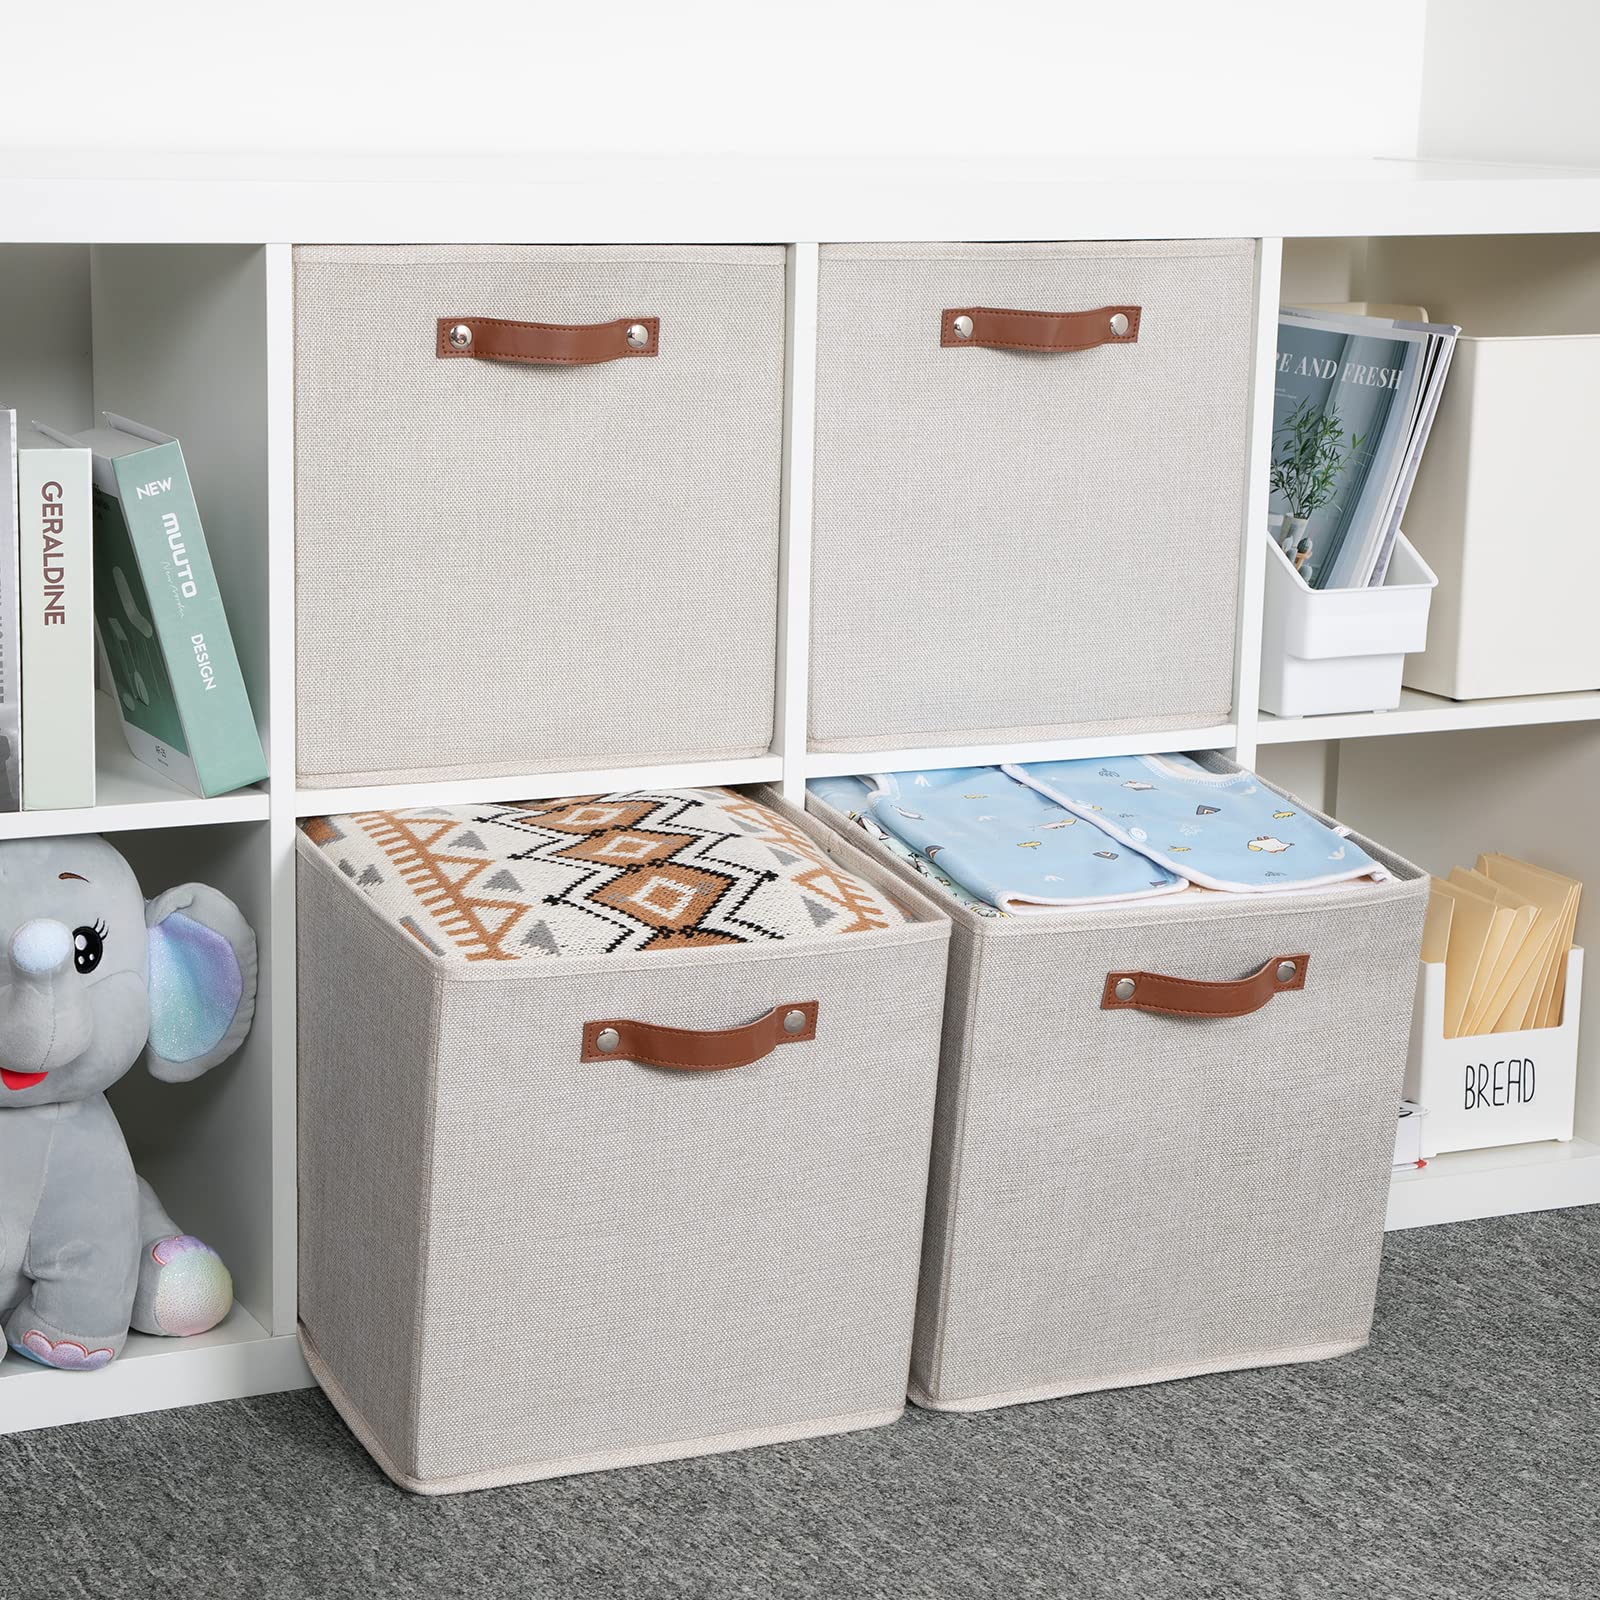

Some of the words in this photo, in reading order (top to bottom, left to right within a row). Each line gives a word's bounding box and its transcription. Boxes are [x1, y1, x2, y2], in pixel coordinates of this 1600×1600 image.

[1294, 356, 1338, 380] AND
[1341, 362, 1404, 390] FRESH
[136, 476, 172, 500] NEW
[41, 480, 65, 627] GERALDINE
[161, 512, 198, 599] MUUTO
[191, 633, 217, 691] DESIGN
[1464, 1058, 1536, 1110] BREAD
